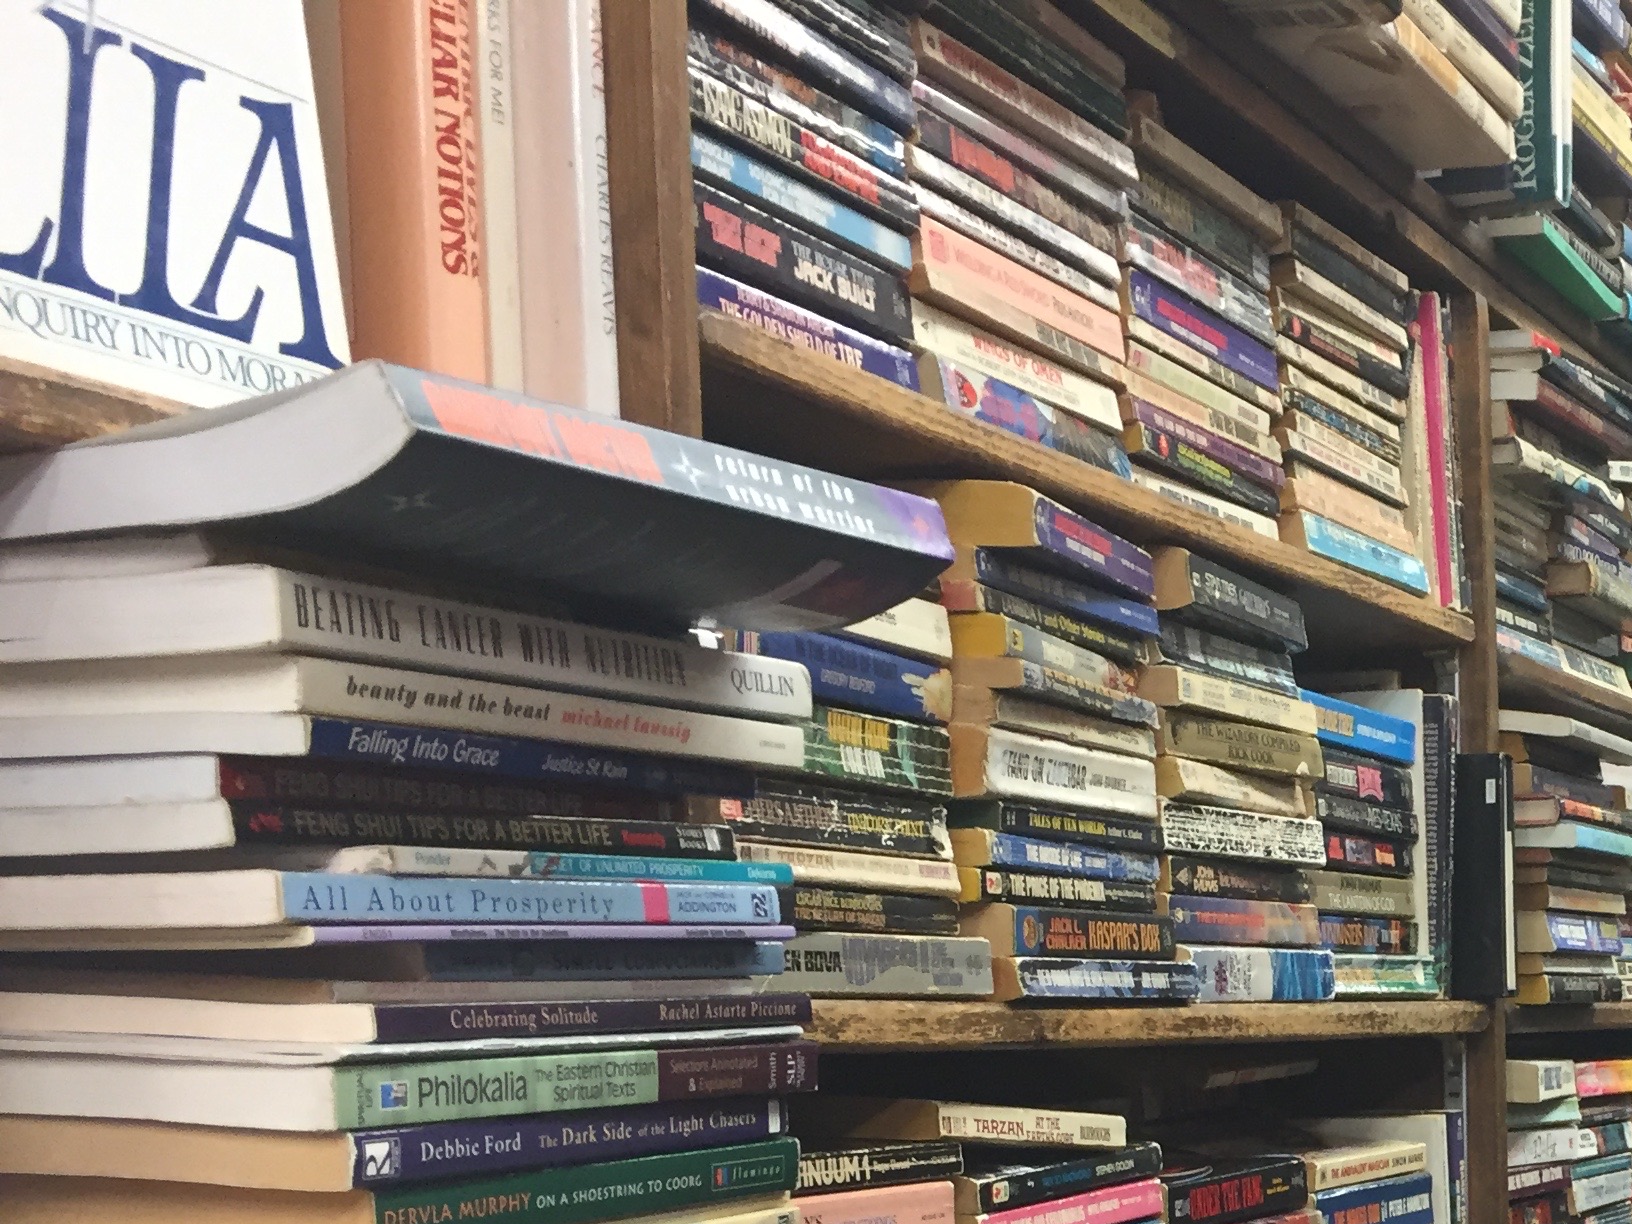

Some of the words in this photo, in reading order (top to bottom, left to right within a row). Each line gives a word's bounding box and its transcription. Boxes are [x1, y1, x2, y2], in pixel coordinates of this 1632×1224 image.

[0, 5, 350, 370] ILA
[434, 107, 468, 278] NOTIONS
[130, 322, 212, 377] INTO
[713, 453, 784, 487] return
[791, 471, 814, 495] of
[821, 474, 856, 506] the
[723, 482, 791, 514] urban
[797, 499, 877, 536] warrior
[293, 581, 402, 645] BEATING
[417, 604, 505, 660] CANCER
[516, 620, 573, 670] WITH
[729, 666, 797, 700] QUILLIN
[345, 673, 419, 717] beauty
[423, 686, 464, 715] and
[468, 688, 499, 716] the
[503, 693, 553, 724] beast
[560, 706, 631, 734] michael
[347, 726, 409, 765] Falling
[411, 731, 451, 762] Into
[451, 734, 501, 768] Grace
[293, 809, 350, 839] FENG
[353, 811, 402, 842] SHUI
[405, 814, 449, 842] TIPS
[451, 816, 491, 843] FOR
[492, 818, 508, 844] A
[508, 819, 574, 846] BETTER
[576, 821, 614, 848] LIFE
[302, 884, 349, 913] All
[365, 885, 456, 914] About
[470, 888, 616, 921] Prosperity
[676, 899, 738, 916] ADDINGTON
[1088, 920, 1140, 952] KASPAR'S
[449, 1007, 538, 1032] Celebrating
[540, 1005, 599, 1027] Solitude
[658, 1001, 701, 1022] Rachel
[703, 1001, 748, 1020] Astarte
[416, 1070, 528, 1109] Philokalia
[535, 1066, 555, 1082] The
[555, 1062, 603, 1083] Eastern
[604, 1057, 658, 1079] Christian
[553, 1079, 601, 1103] Spiritual
[601, 1079, 637, 1098] Texts
[420, 1135, 482, 1163] Debbie
[483, 1132, 523, 1156] Ford
[537, 1133, 560, 1150] The
[560, 1124, 601, 1148] Dark
[601, 1120, 634, 1142] Side
[636, 1125, 648, 1137] of
[648, 1121, 667, 1136] the
[667, 1113, 706, 1138] Light
[707, 1109, 758, 1133] Chasers
[973, 1118, 1026, 1137] TARZAN
[457, 1191, 533, 1221] MURPHY
[535, 1193, 557, 1210] ON
[558, 1191, 571, 1207] A
[571, 1181, 646, 1206] SHOESTRING
[647, 1179, 663, 1197] TO
[663, 1173, 703, 1195] COORG
